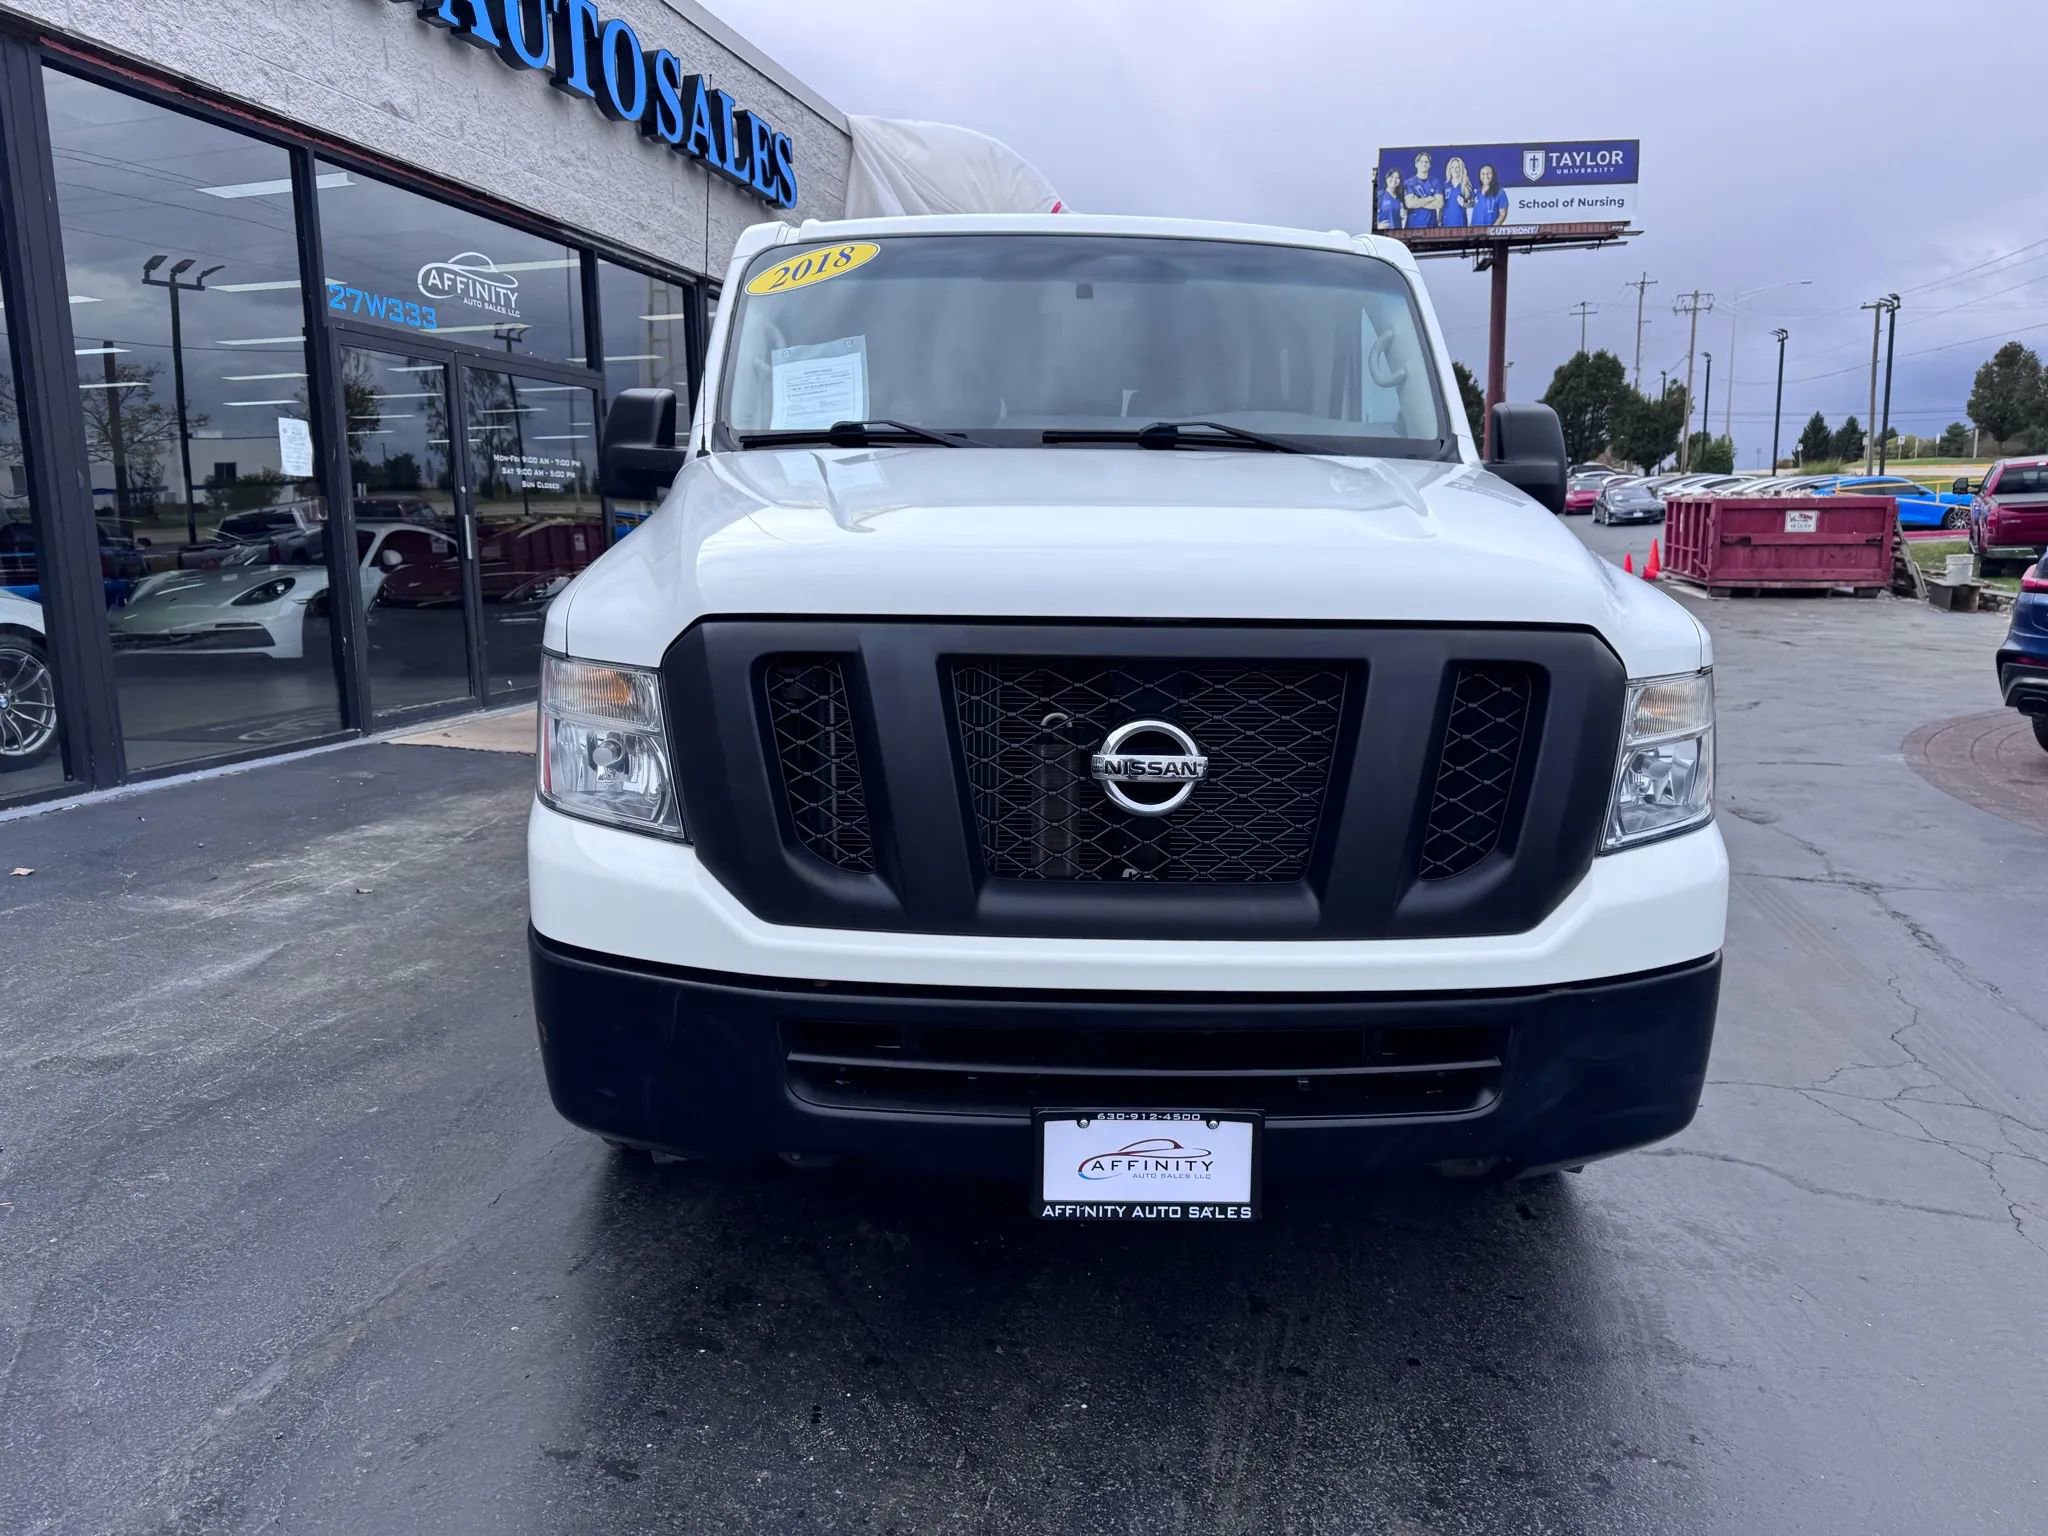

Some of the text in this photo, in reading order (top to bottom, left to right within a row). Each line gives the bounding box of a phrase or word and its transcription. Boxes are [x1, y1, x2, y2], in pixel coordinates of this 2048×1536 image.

[655, 48, 799, 210] SALES
[1549, 150, 1624, 167] TAYLOR
[1556, 167, 1615, 175] UNIVERSITY
[1518, 196, 1625, 209] School of Nursing
[768, 246, 855, 291] 2018
[428, 269, 518, 308] AFFINITY
[328, 284, 438, 330] 27W333
[463, 297, 520, 318] AUTO SALES LLC
[521, 456, 538, 464] 9:00
[555, 459, 570, 467] 7:00
[571, 460, 581, 468] PM
[516, 468, 532, 476] 9:00
[1104, 760, 1198, 776] NISSAN
[1097, 1113, 1200, 1121] 630-912-4500
[1091, 1160, 1214, 1172] AFFINITY
[1042, 1205, 1252, 1219] AFFINITY AUTO SALES
